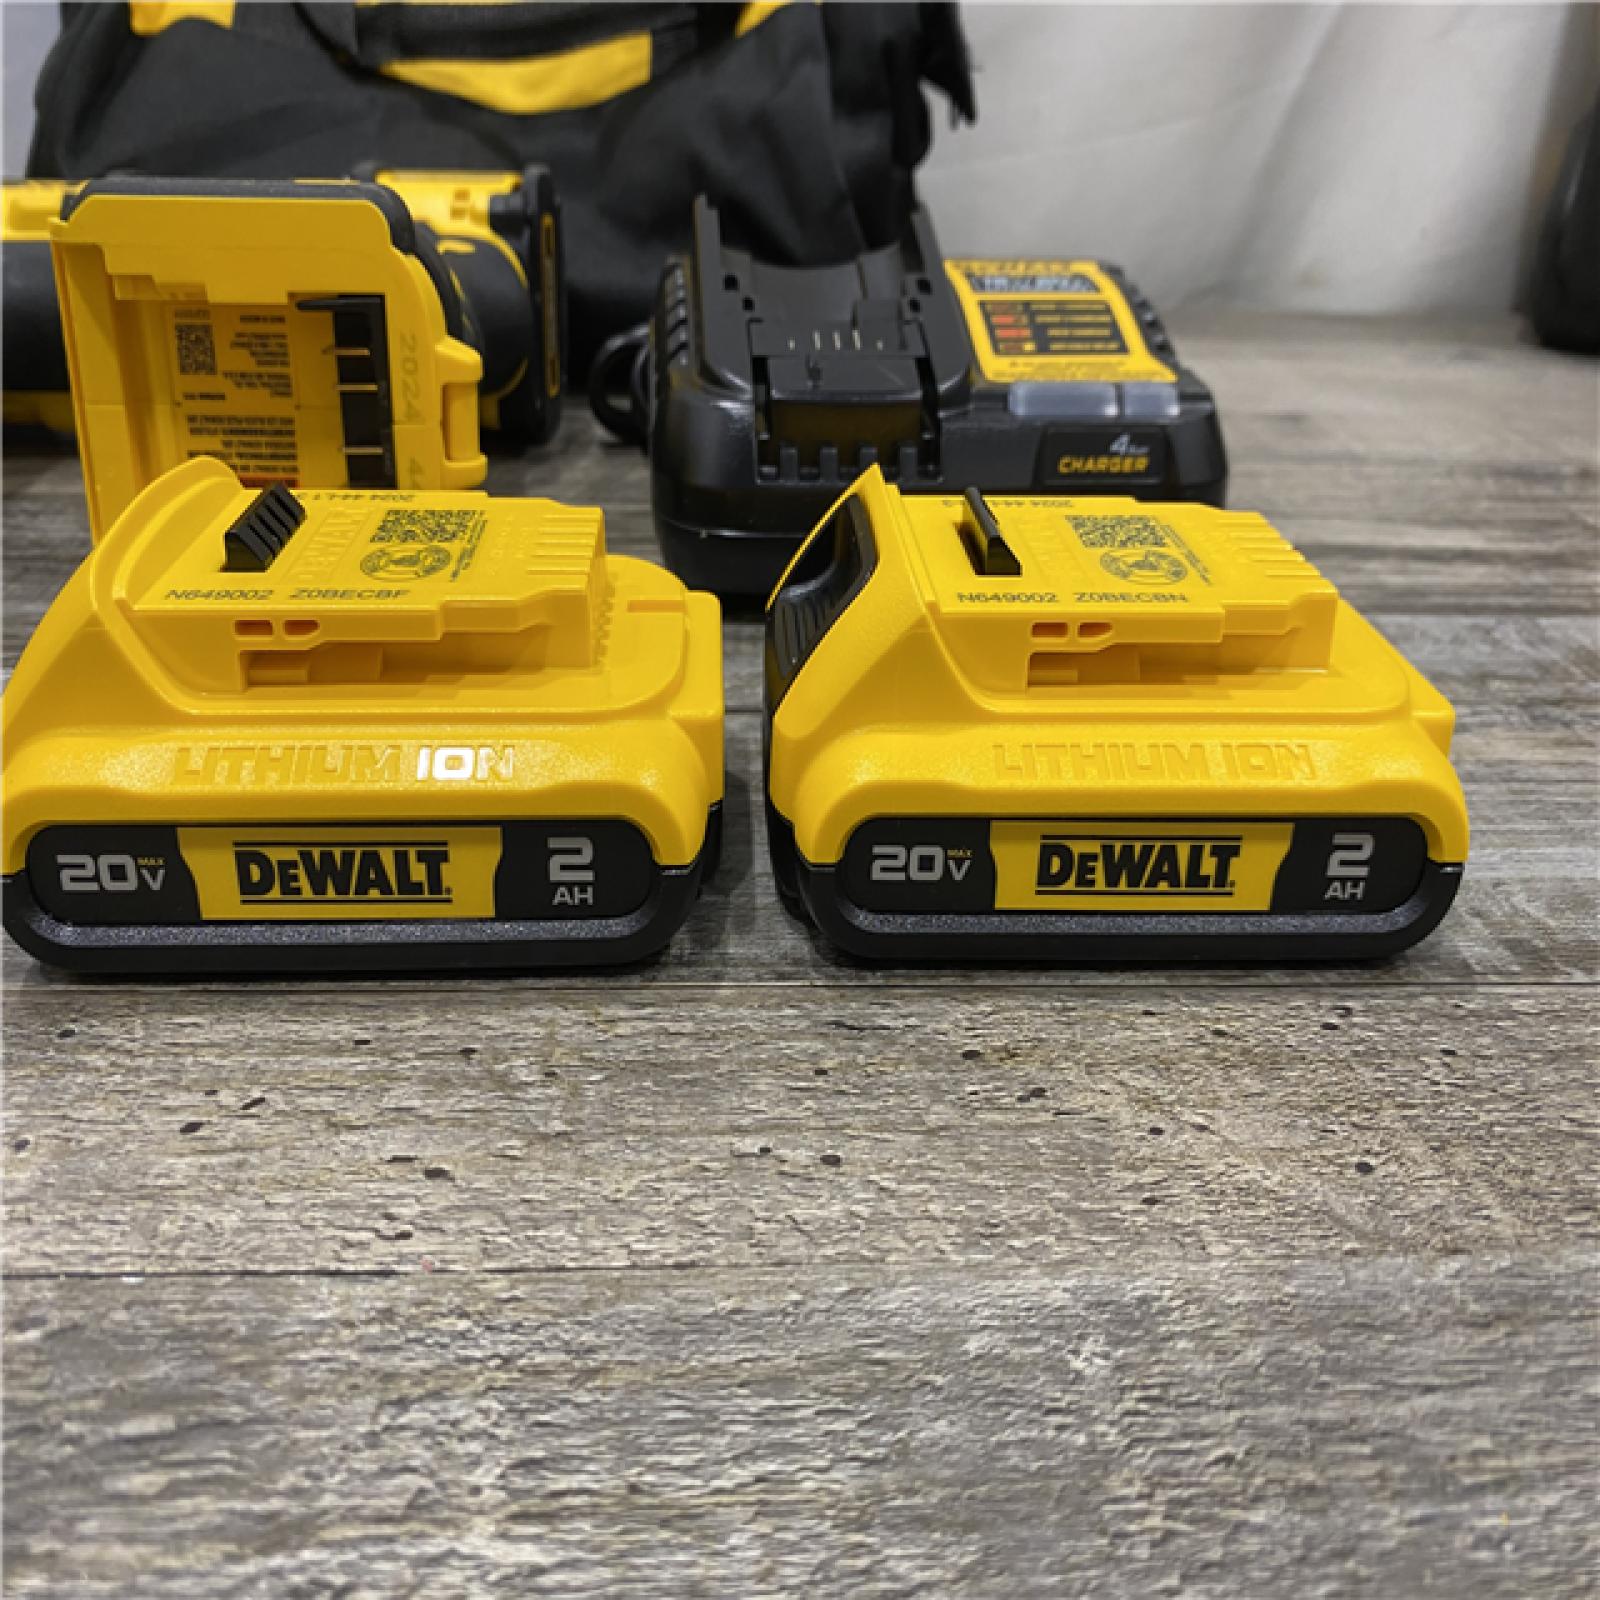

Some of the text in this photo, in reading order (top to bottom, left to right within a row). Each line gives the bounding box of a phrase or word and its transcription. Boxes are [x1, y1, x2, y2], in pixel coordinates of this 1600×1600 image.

[1058, 455, 1149, 473] CHARGER
[172, 745, 516, 785] LITHIUM ION
[991, 744, 1317, 781] LITHIUM ION
[547, 837, 595, 883] 2
[1327, 832, 1374, 878] 2
[553, 886, 595, 907] AH
[1324, 880, 1366, 900] AH
